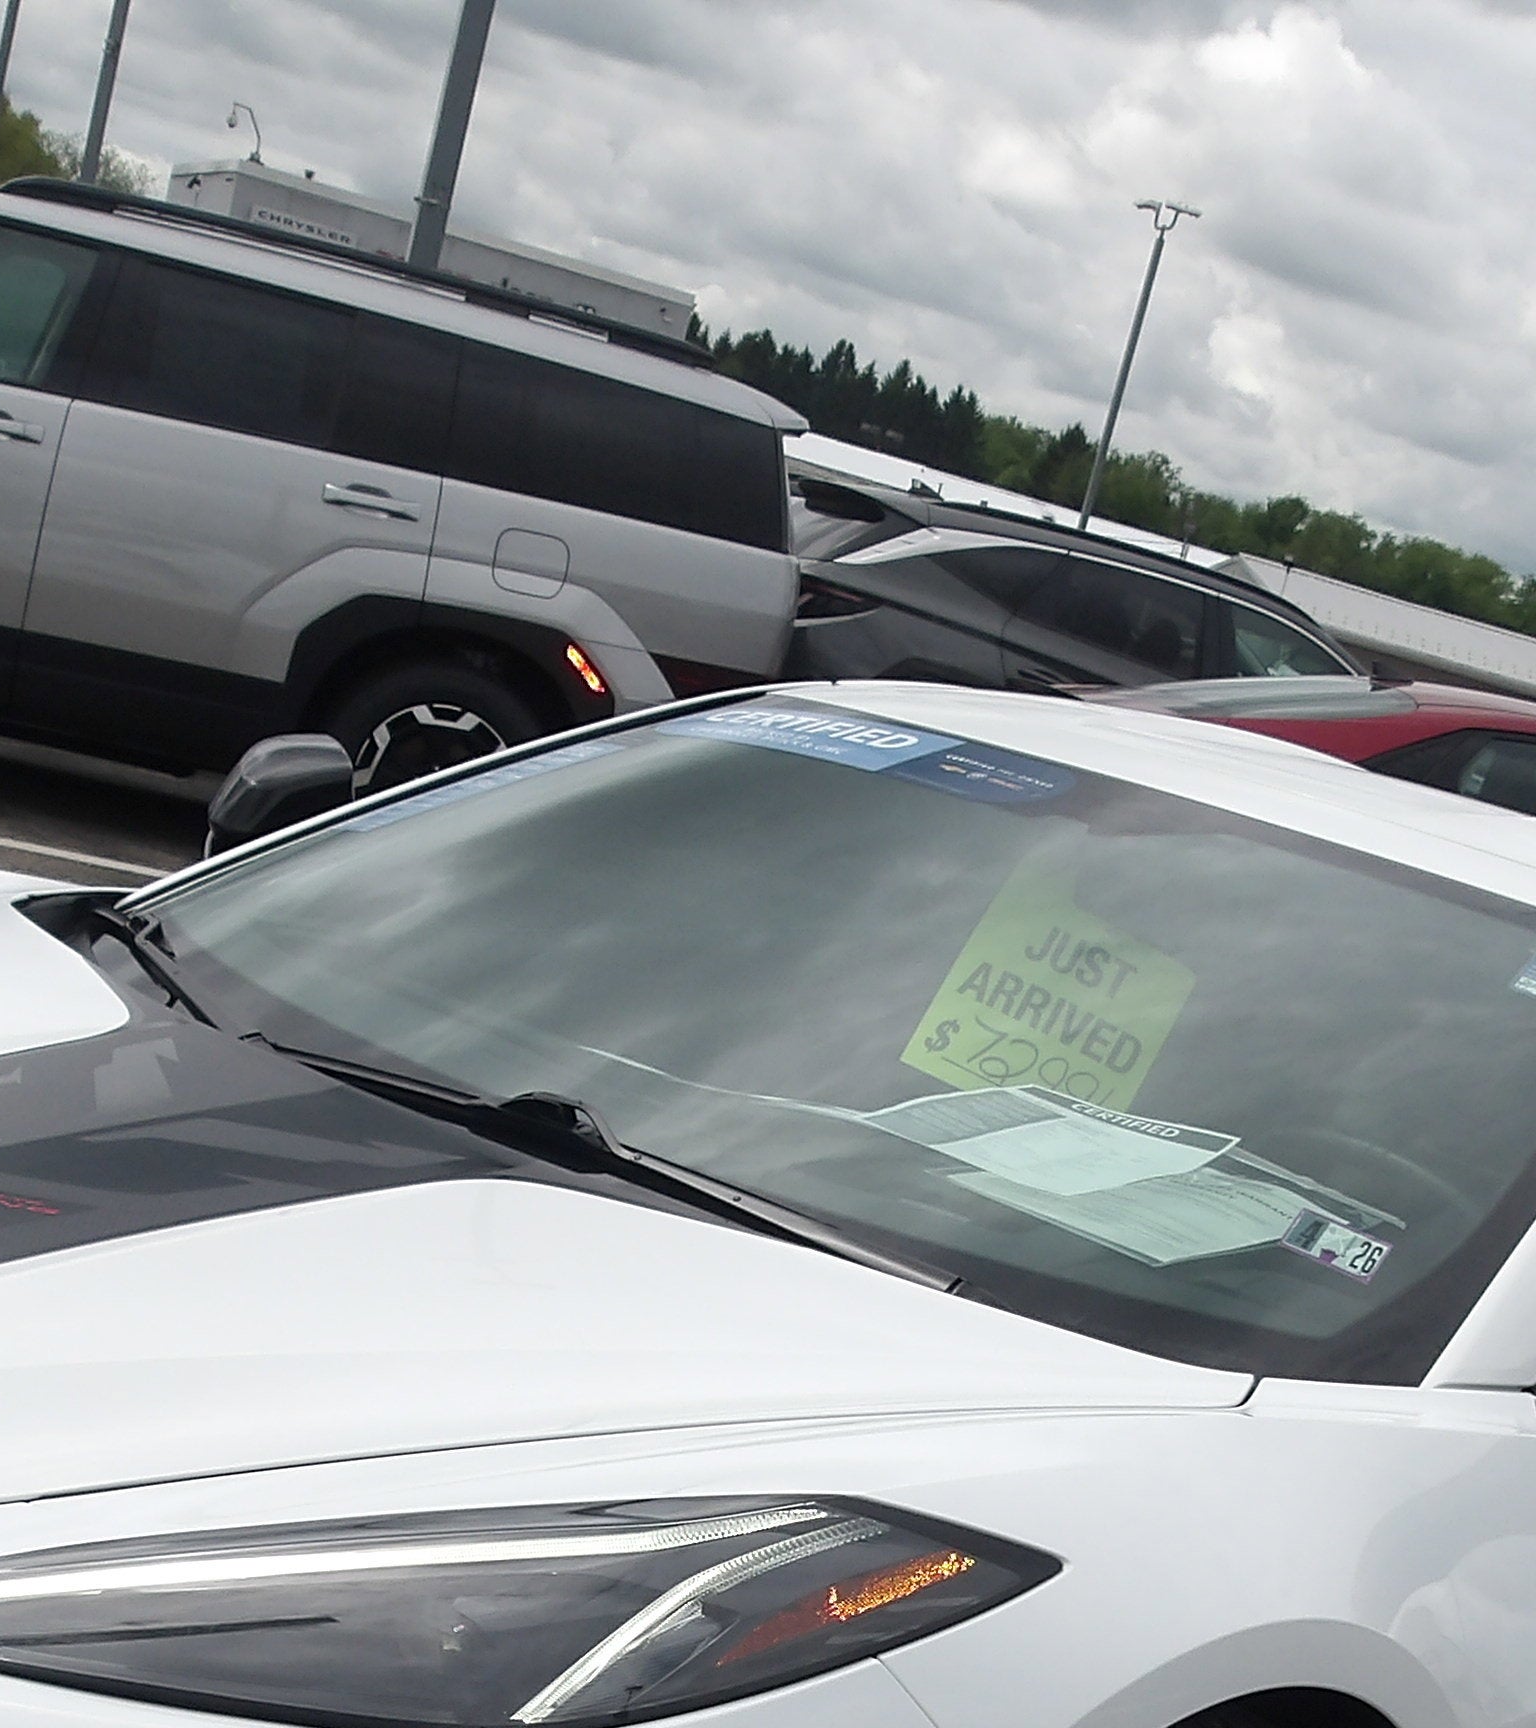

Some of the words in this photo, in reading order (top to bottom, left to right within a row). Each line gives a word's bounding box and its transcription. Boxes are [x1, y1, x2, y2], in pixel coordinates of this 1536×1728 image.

[257, 210, 351, 243] CHRYSLER
[706, 710, 920, 749] CERTIFIED
[1025, 926, 1138, 998] JUST
[924, 1018, 960, 1053] $
[956, 961, 1142, 1075] ARRIVED
[1070, 1101, 1181, 1140] CERTIFIED
[1348, 1240, 1383, 1274] 26
